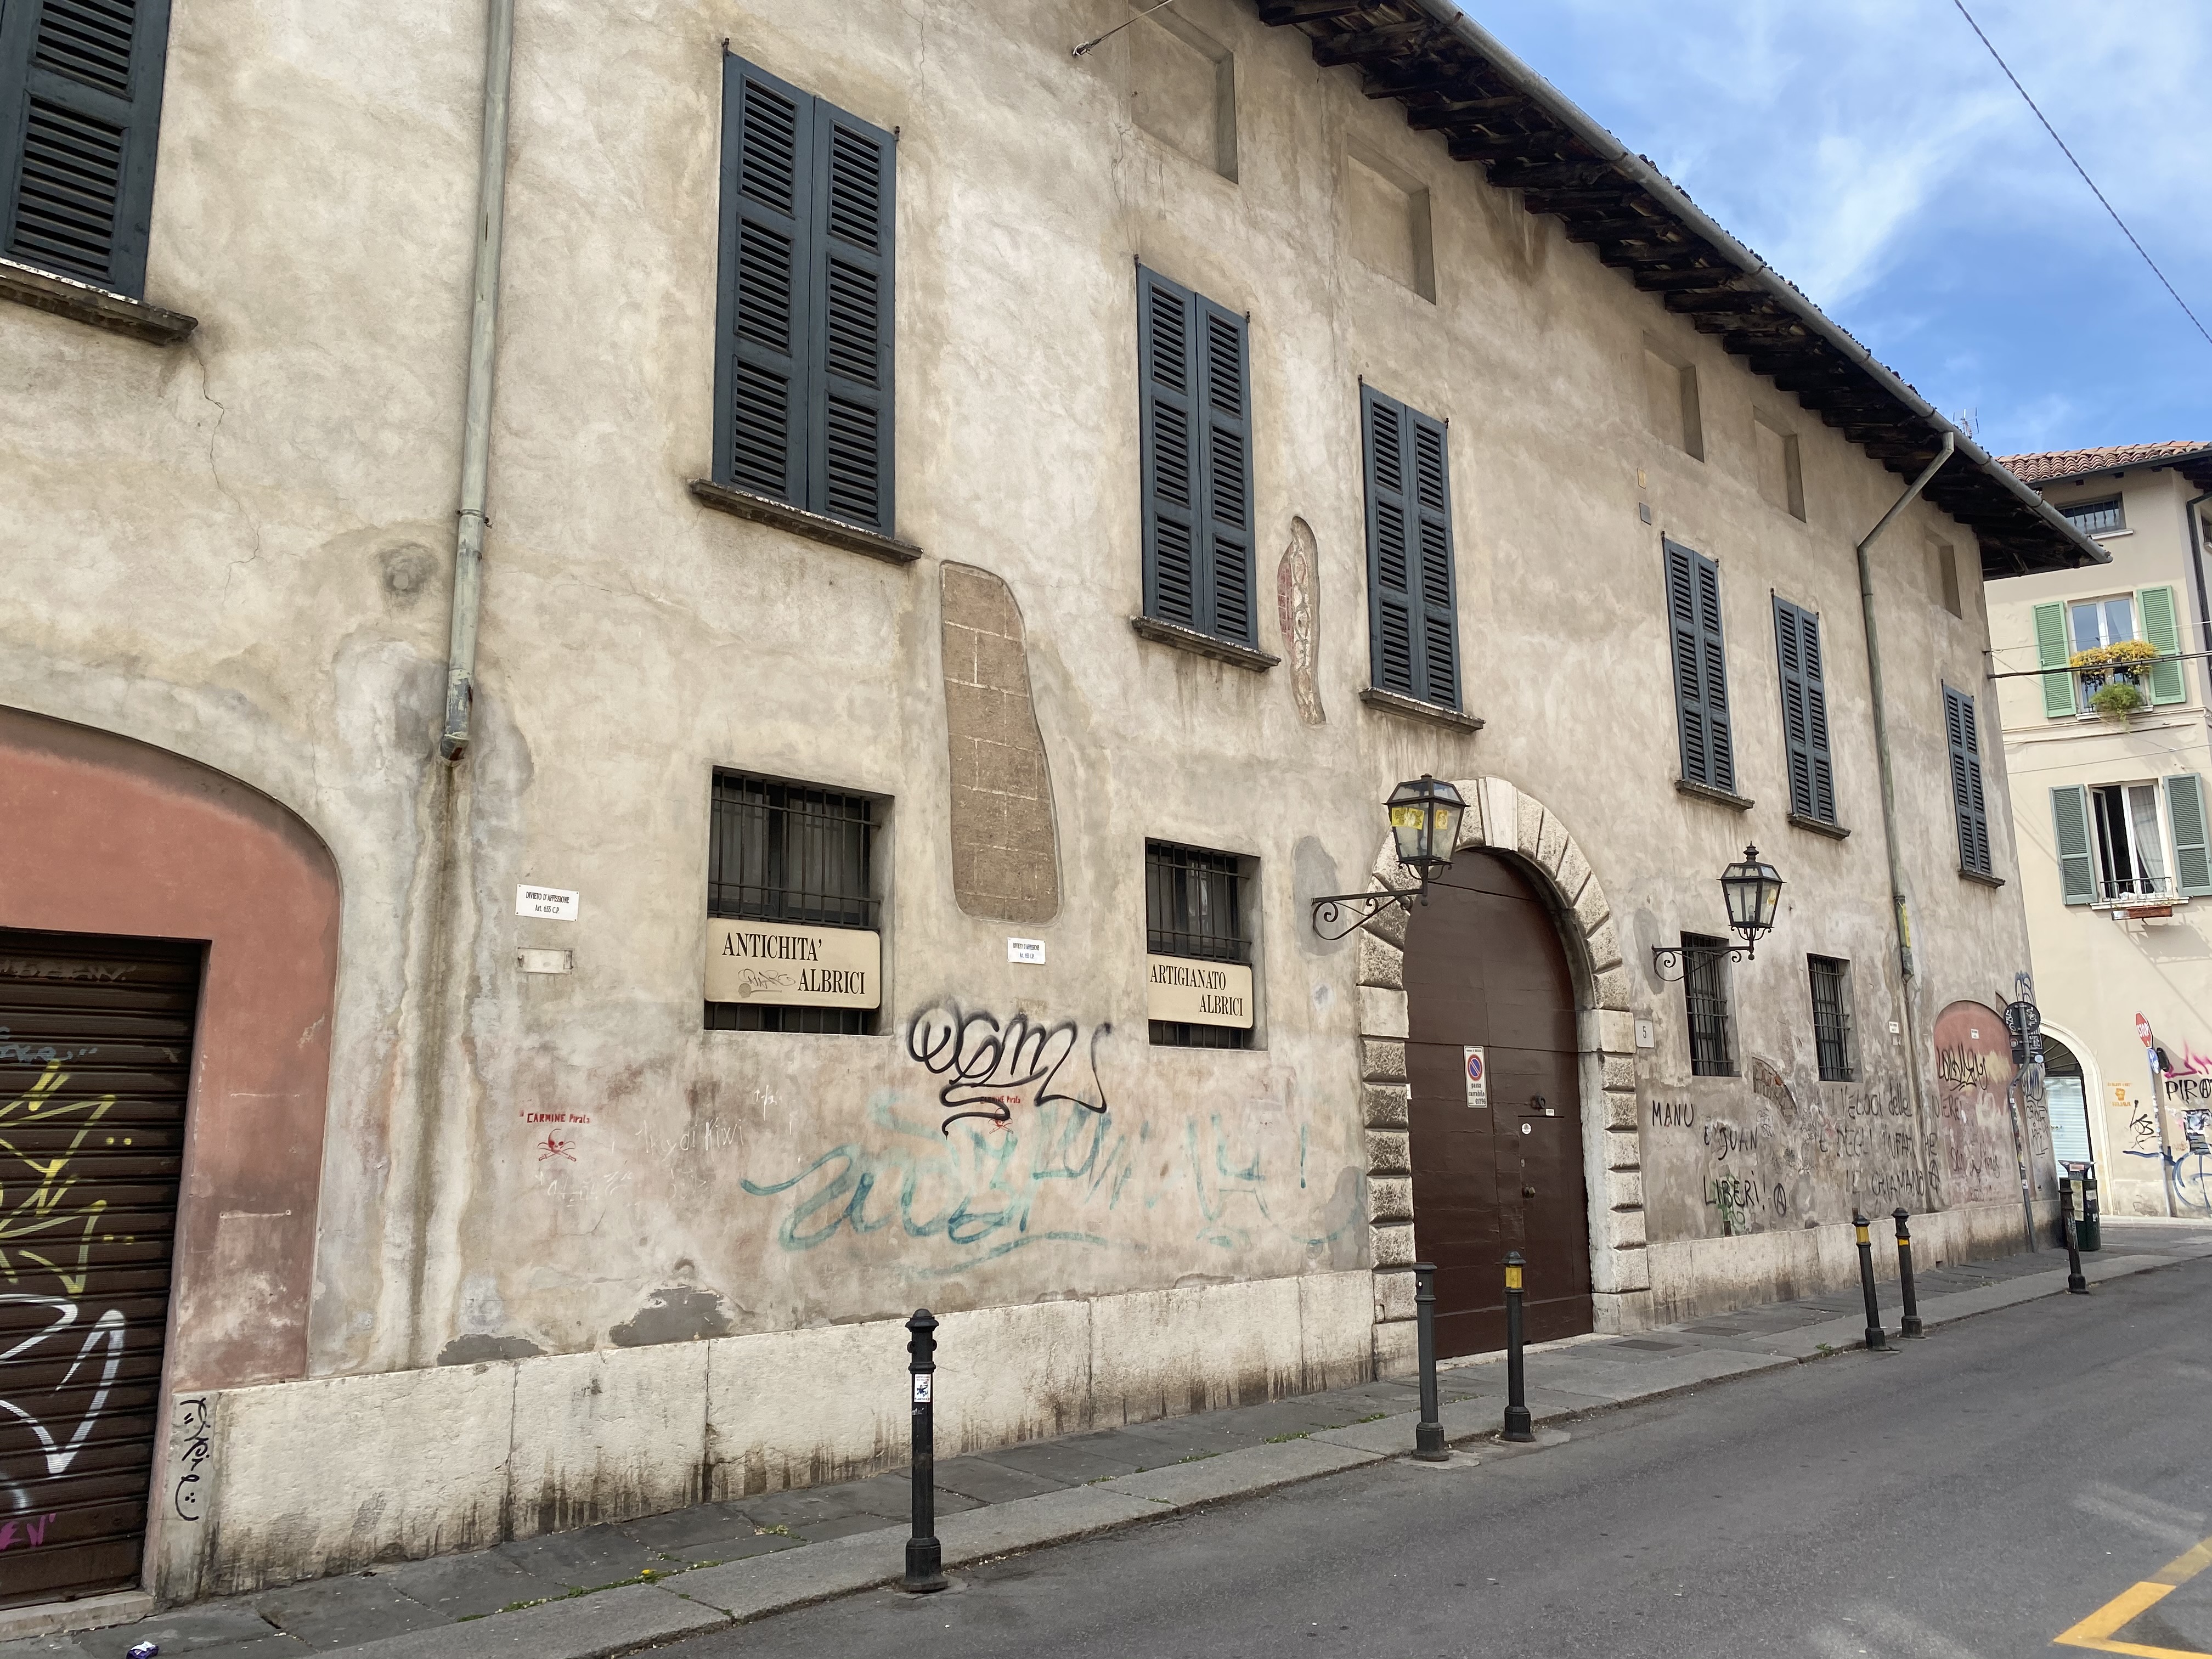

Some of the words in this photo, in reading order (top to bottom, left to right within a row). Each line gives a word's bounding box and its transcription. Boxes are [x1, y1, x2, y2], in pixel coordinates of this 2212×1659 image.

[526, 891, 542, 900] DIVIETO
[722, 932, 822, 961] ANTICHITA'
[797, 968, 865, 995] ALBRICI
[1150, 963, 1226, 991] ARTIGIANATO
[1199, 994, 1243, 1017] ALBRICI
[1643, 1025, 1647, 1039] 5
[2137, 1023, 2149, 1037] STOP
[1888, 1079, 1913, 1118] delle
[527, 1113, 566, 1123] CARMINE
[1652, 1099, 1694, 1127] MANU
[1718, 1126, 1758, 1161] JUAN
